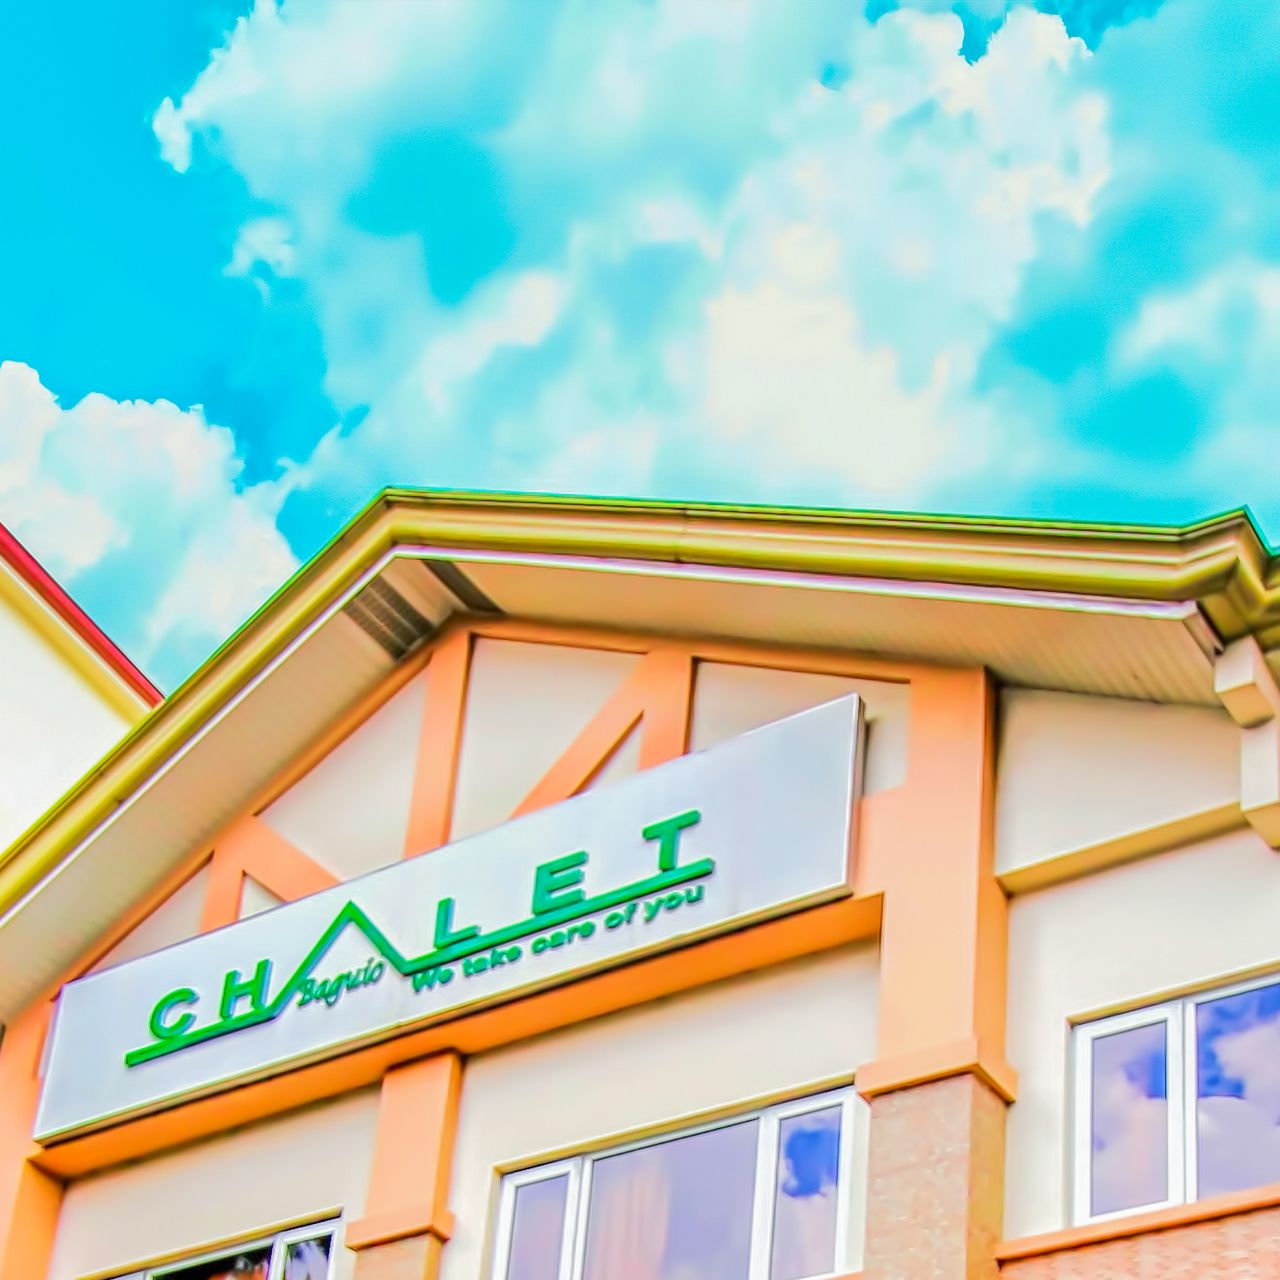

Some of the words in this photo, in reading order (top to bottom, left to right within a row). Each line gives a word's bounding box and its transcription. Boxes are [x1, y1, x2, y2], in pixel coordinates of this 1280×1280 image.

[147, 809, 704, 1042] CHALET
[412, 963, 456, 994] We
[462, 943, 523, 978] take
[531, 920, 597, 955] care
[604, 900, 639, 931] of
[643, 884, 705, 923] you
[293, 956, 388, 1009] Baguio
